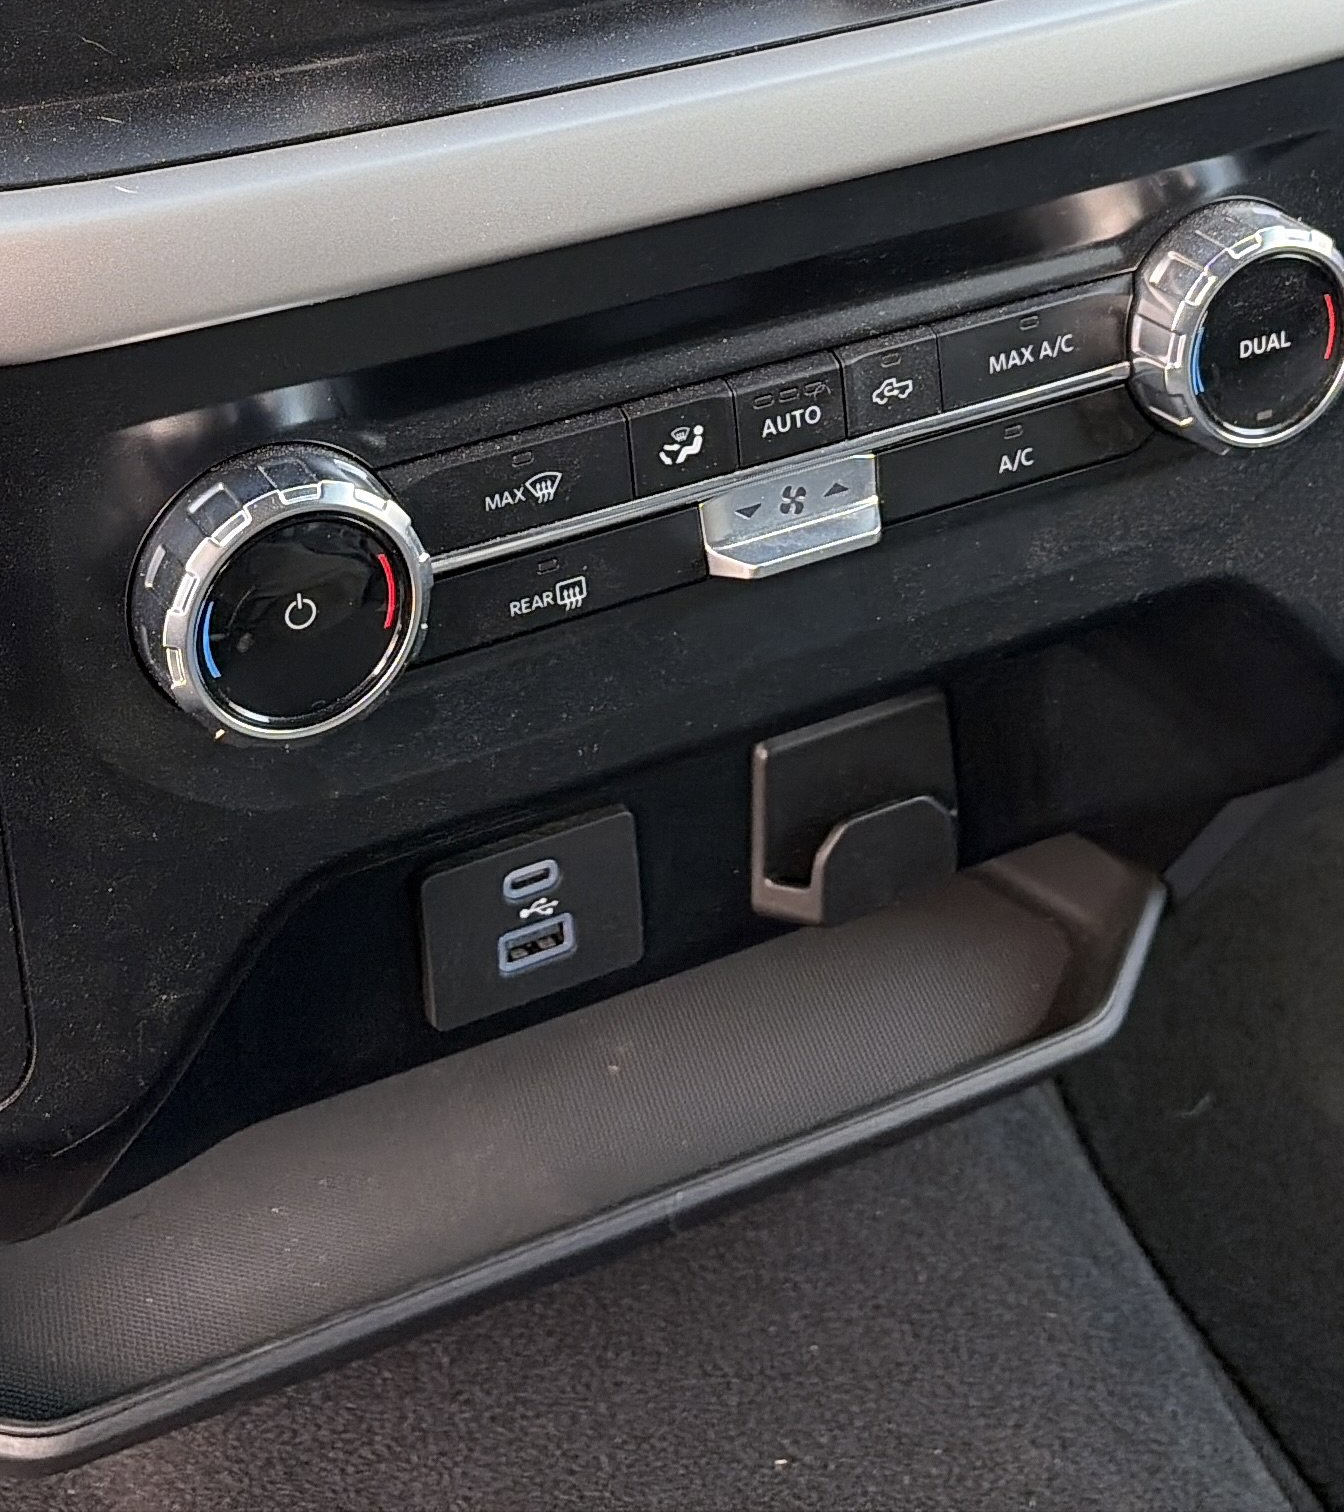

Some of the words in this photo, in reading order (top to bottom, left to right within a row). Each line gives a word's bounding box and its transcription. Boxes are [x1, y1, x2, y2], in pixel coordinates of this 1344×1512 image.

[987, 347, 1035, 375] MAX
[1038, 332, 1075, 360] A/C
[1239, 329, 1292, 359] DUAL
[761, 404, 823, 438] AUTO
[997, 446, 1035, 474] A/C
[484, 485, 527, 512] MAX
[509, 590, 555, 617] REAR
